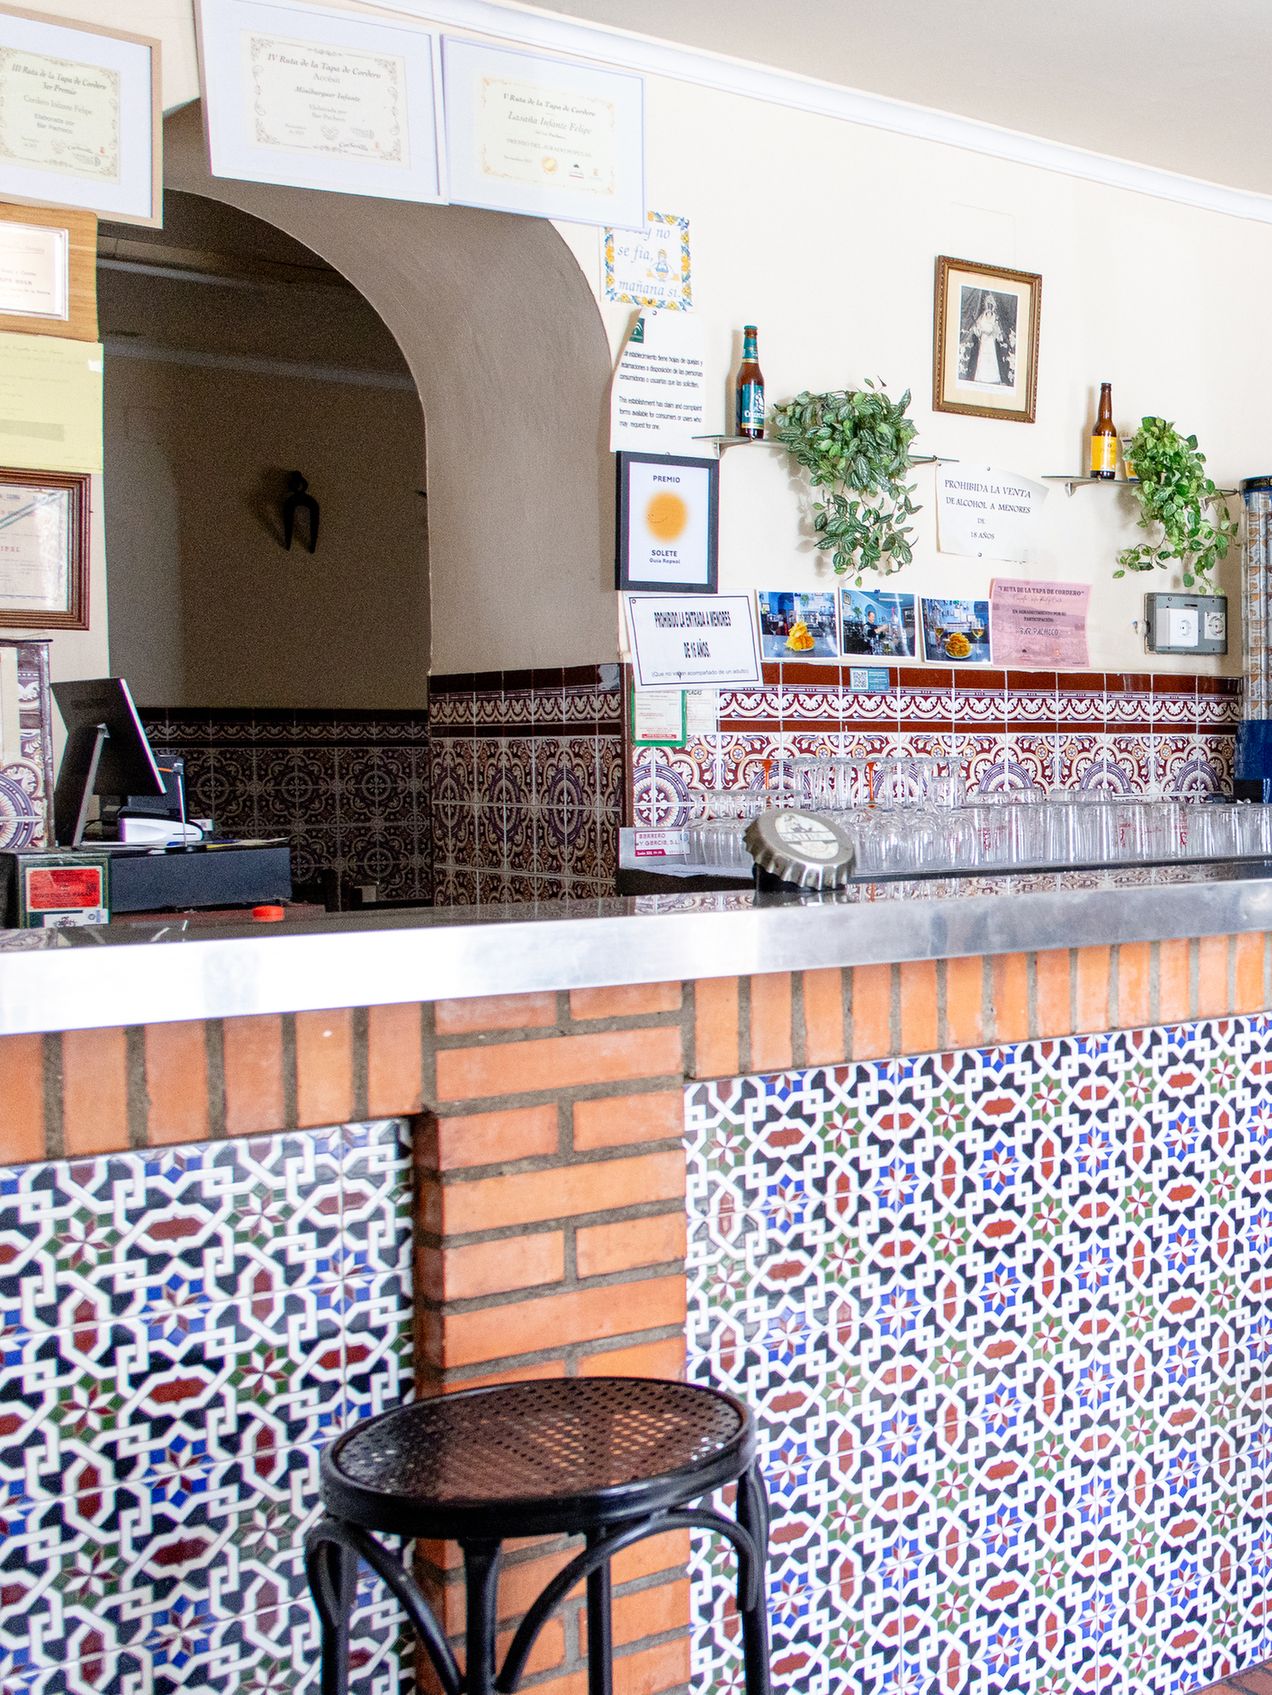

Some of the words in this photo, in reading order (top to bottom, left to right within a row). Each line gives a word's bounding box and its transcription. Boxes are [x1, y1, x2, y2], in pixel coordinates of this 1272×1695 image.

[279, 55, 298, 66] Ruta
[300, 58, 309, 67] de
[310, 60, 319, 68] la
[322, 62, 340, 73] Tapa
[342, 66, 351, 74] de
[352, 67, 381, 79] Cordero
[509, 94, 526, 103] Ruta
[656, 227, 671, 240] no
[617, 245, 630, 257] se
[618, 279, 664, 296] mañana
[653, 475, 681, 484] PREMIO
[944, 479, 989, 493] PROHIBIDA
[990, 485, 1000, 495] LA
[1002, 487, 1032, 499] VENTA
[946, 496, 955, 505] DE
[956, 498, 987, 510] ALCOHOL
[990, 502, 995, 510] A
[998, 503, 1031, 514] MENORES
[978, 531, 995, 540] AÑOS
[651, 549, 678, 558] SOLETE
[654, 611, 679, 628] PROHIBIDO
[683, 641, 691, 659] DE
